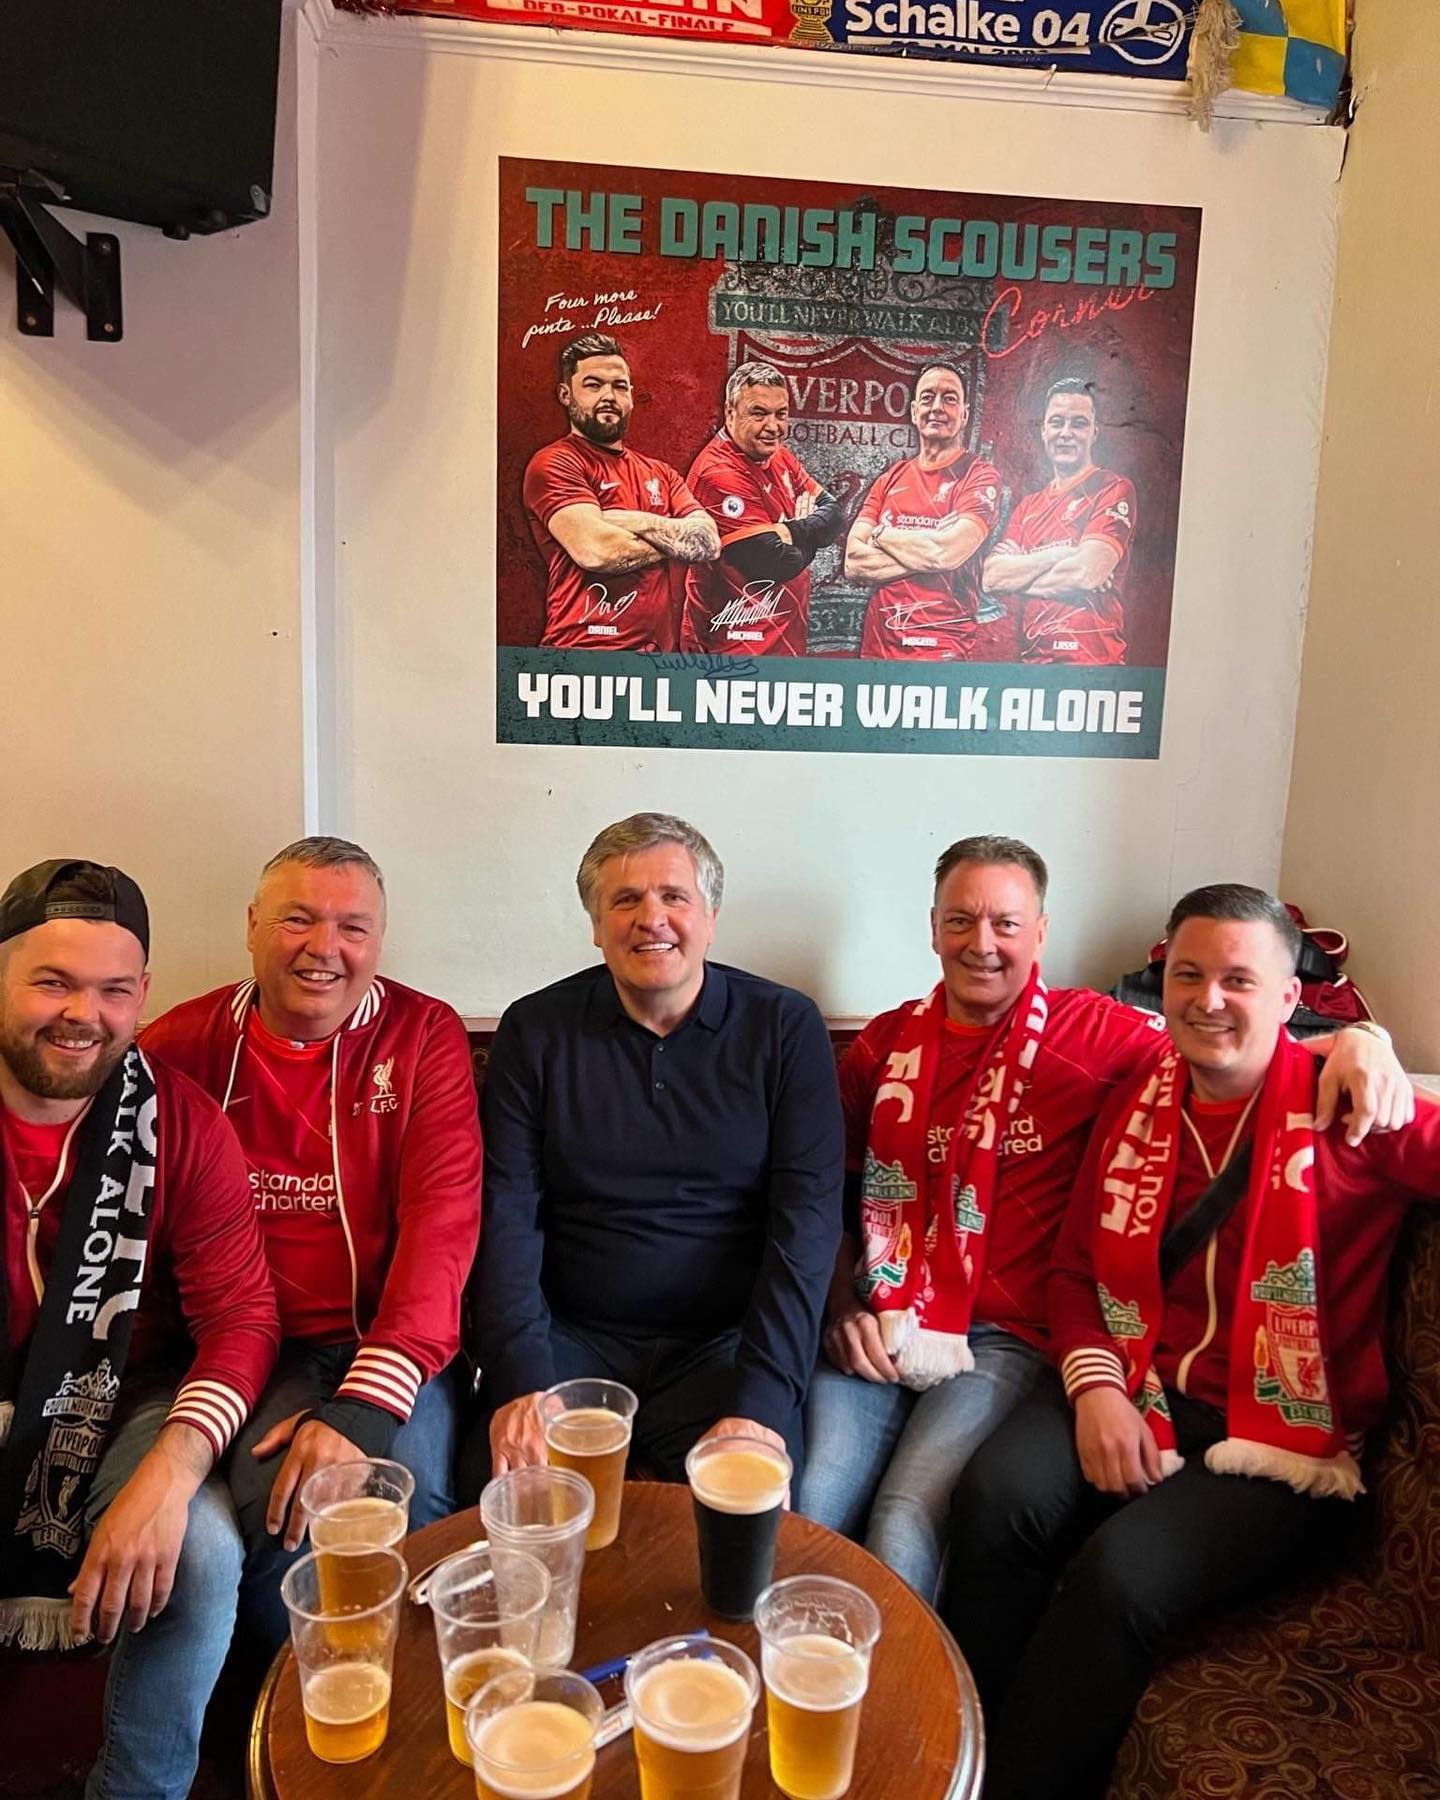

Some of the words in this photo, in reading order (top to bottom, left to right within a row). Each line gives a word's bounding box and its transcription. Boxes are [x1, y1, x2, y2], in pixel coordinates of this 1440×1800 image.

[845, 0, 1020, 44] Schalke
[1031, 9, 1091, 46] 04
[525, 187, 642, 254] THE
[660, 197, 878, 270] DANISH
[893, 215, 1177, 289] SCOUSERS
[544, 292, 589, 313] Four
[594, 290, 638, 305] more
[786, 375, 911, 417] VERPO
[784, 423, 883, 446] OTBALL
[889, 428, 917, 448] CL
[517, 673, 682, 723] YOU'LL
[695, 679, 844, 727] NEVER
[856, 684, 990, 730] WALK
[999, 687, 1143, 734] ALONE
[248, 1169, 334, 1192] standa
[253, 1190, 338, 1212] harter
[1128, 1133, 1172, 1238] YOU'LL
[65, 1174, 125, 1324] ALONE
[1275, 1314, 1317, 1336] LIVERP
